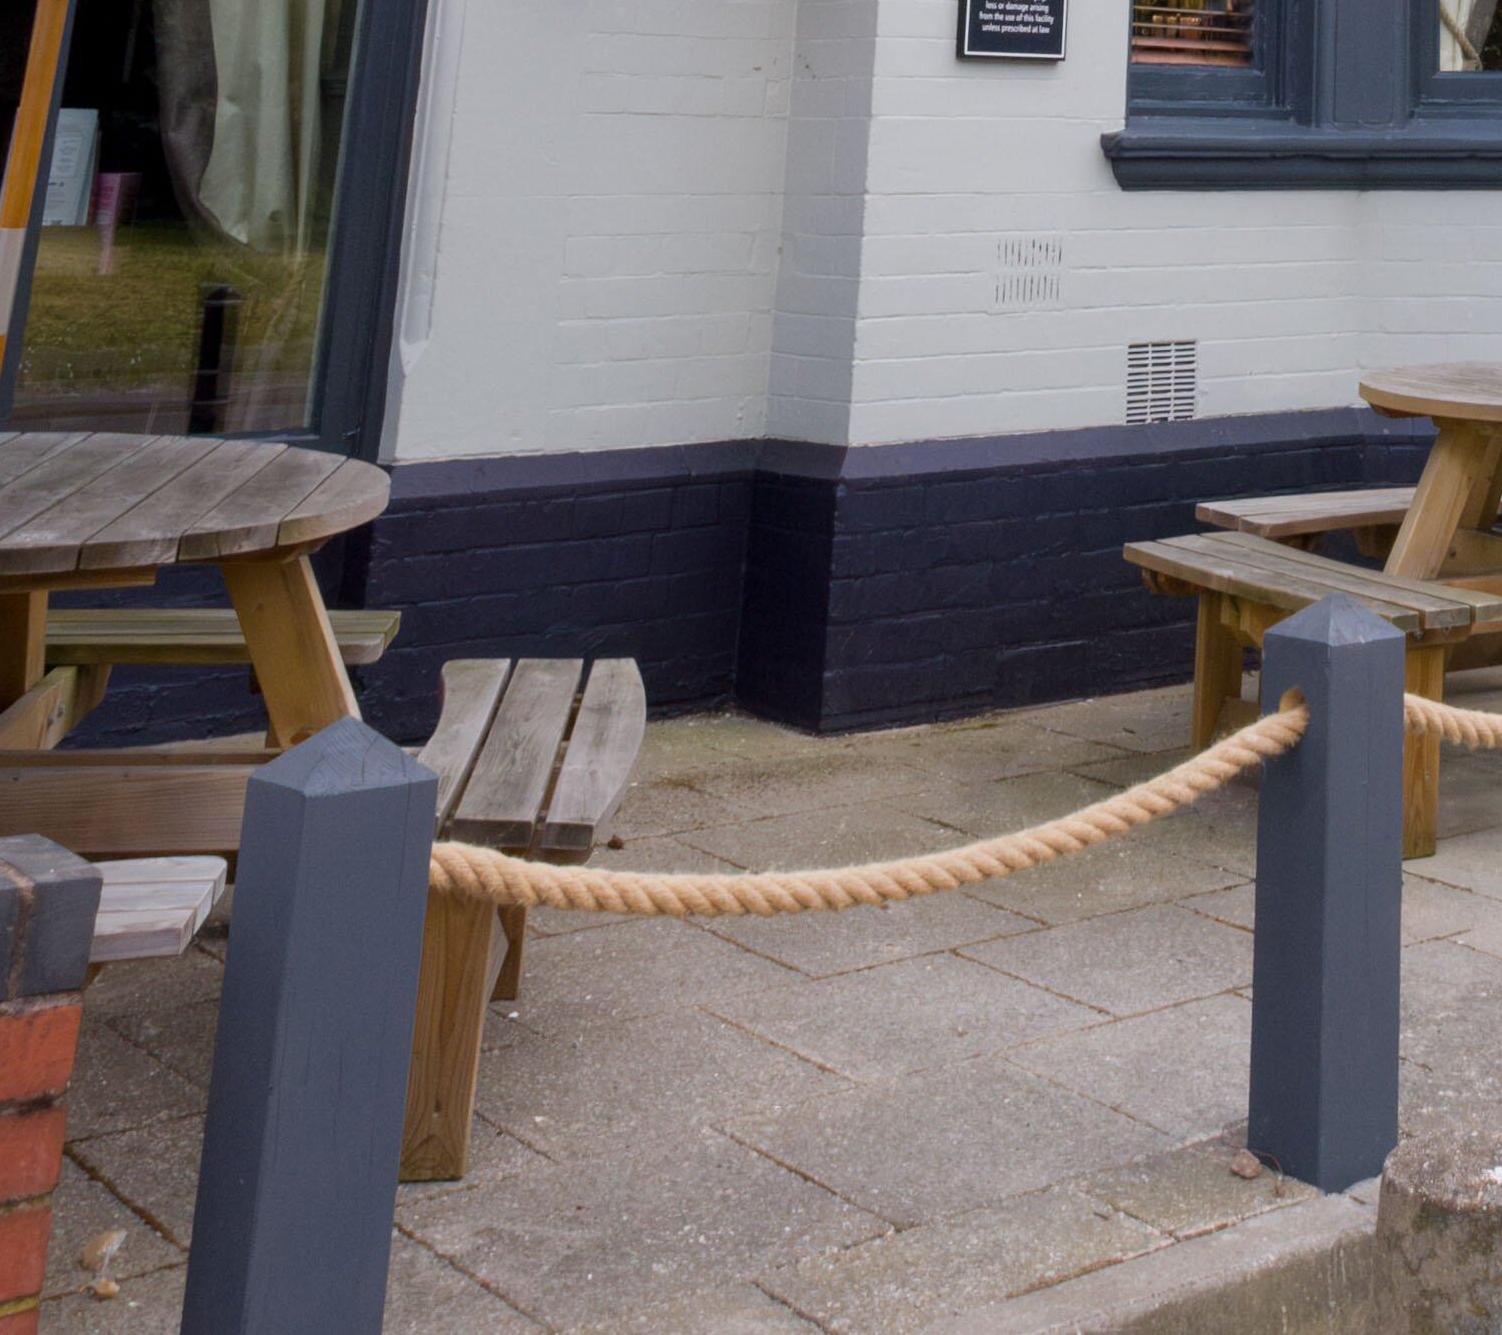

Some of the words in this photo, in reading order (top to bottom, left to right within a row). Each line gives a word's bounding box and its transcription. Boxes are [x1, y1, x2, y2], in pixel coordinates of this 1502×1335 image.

[985, 0, 997, 9] loss
[1005, 1, 1029, 12] damage
[979, 11, 993, 20] from
[994, 12, 1004, 21] the
[1016, 13, 1023, 22] of
